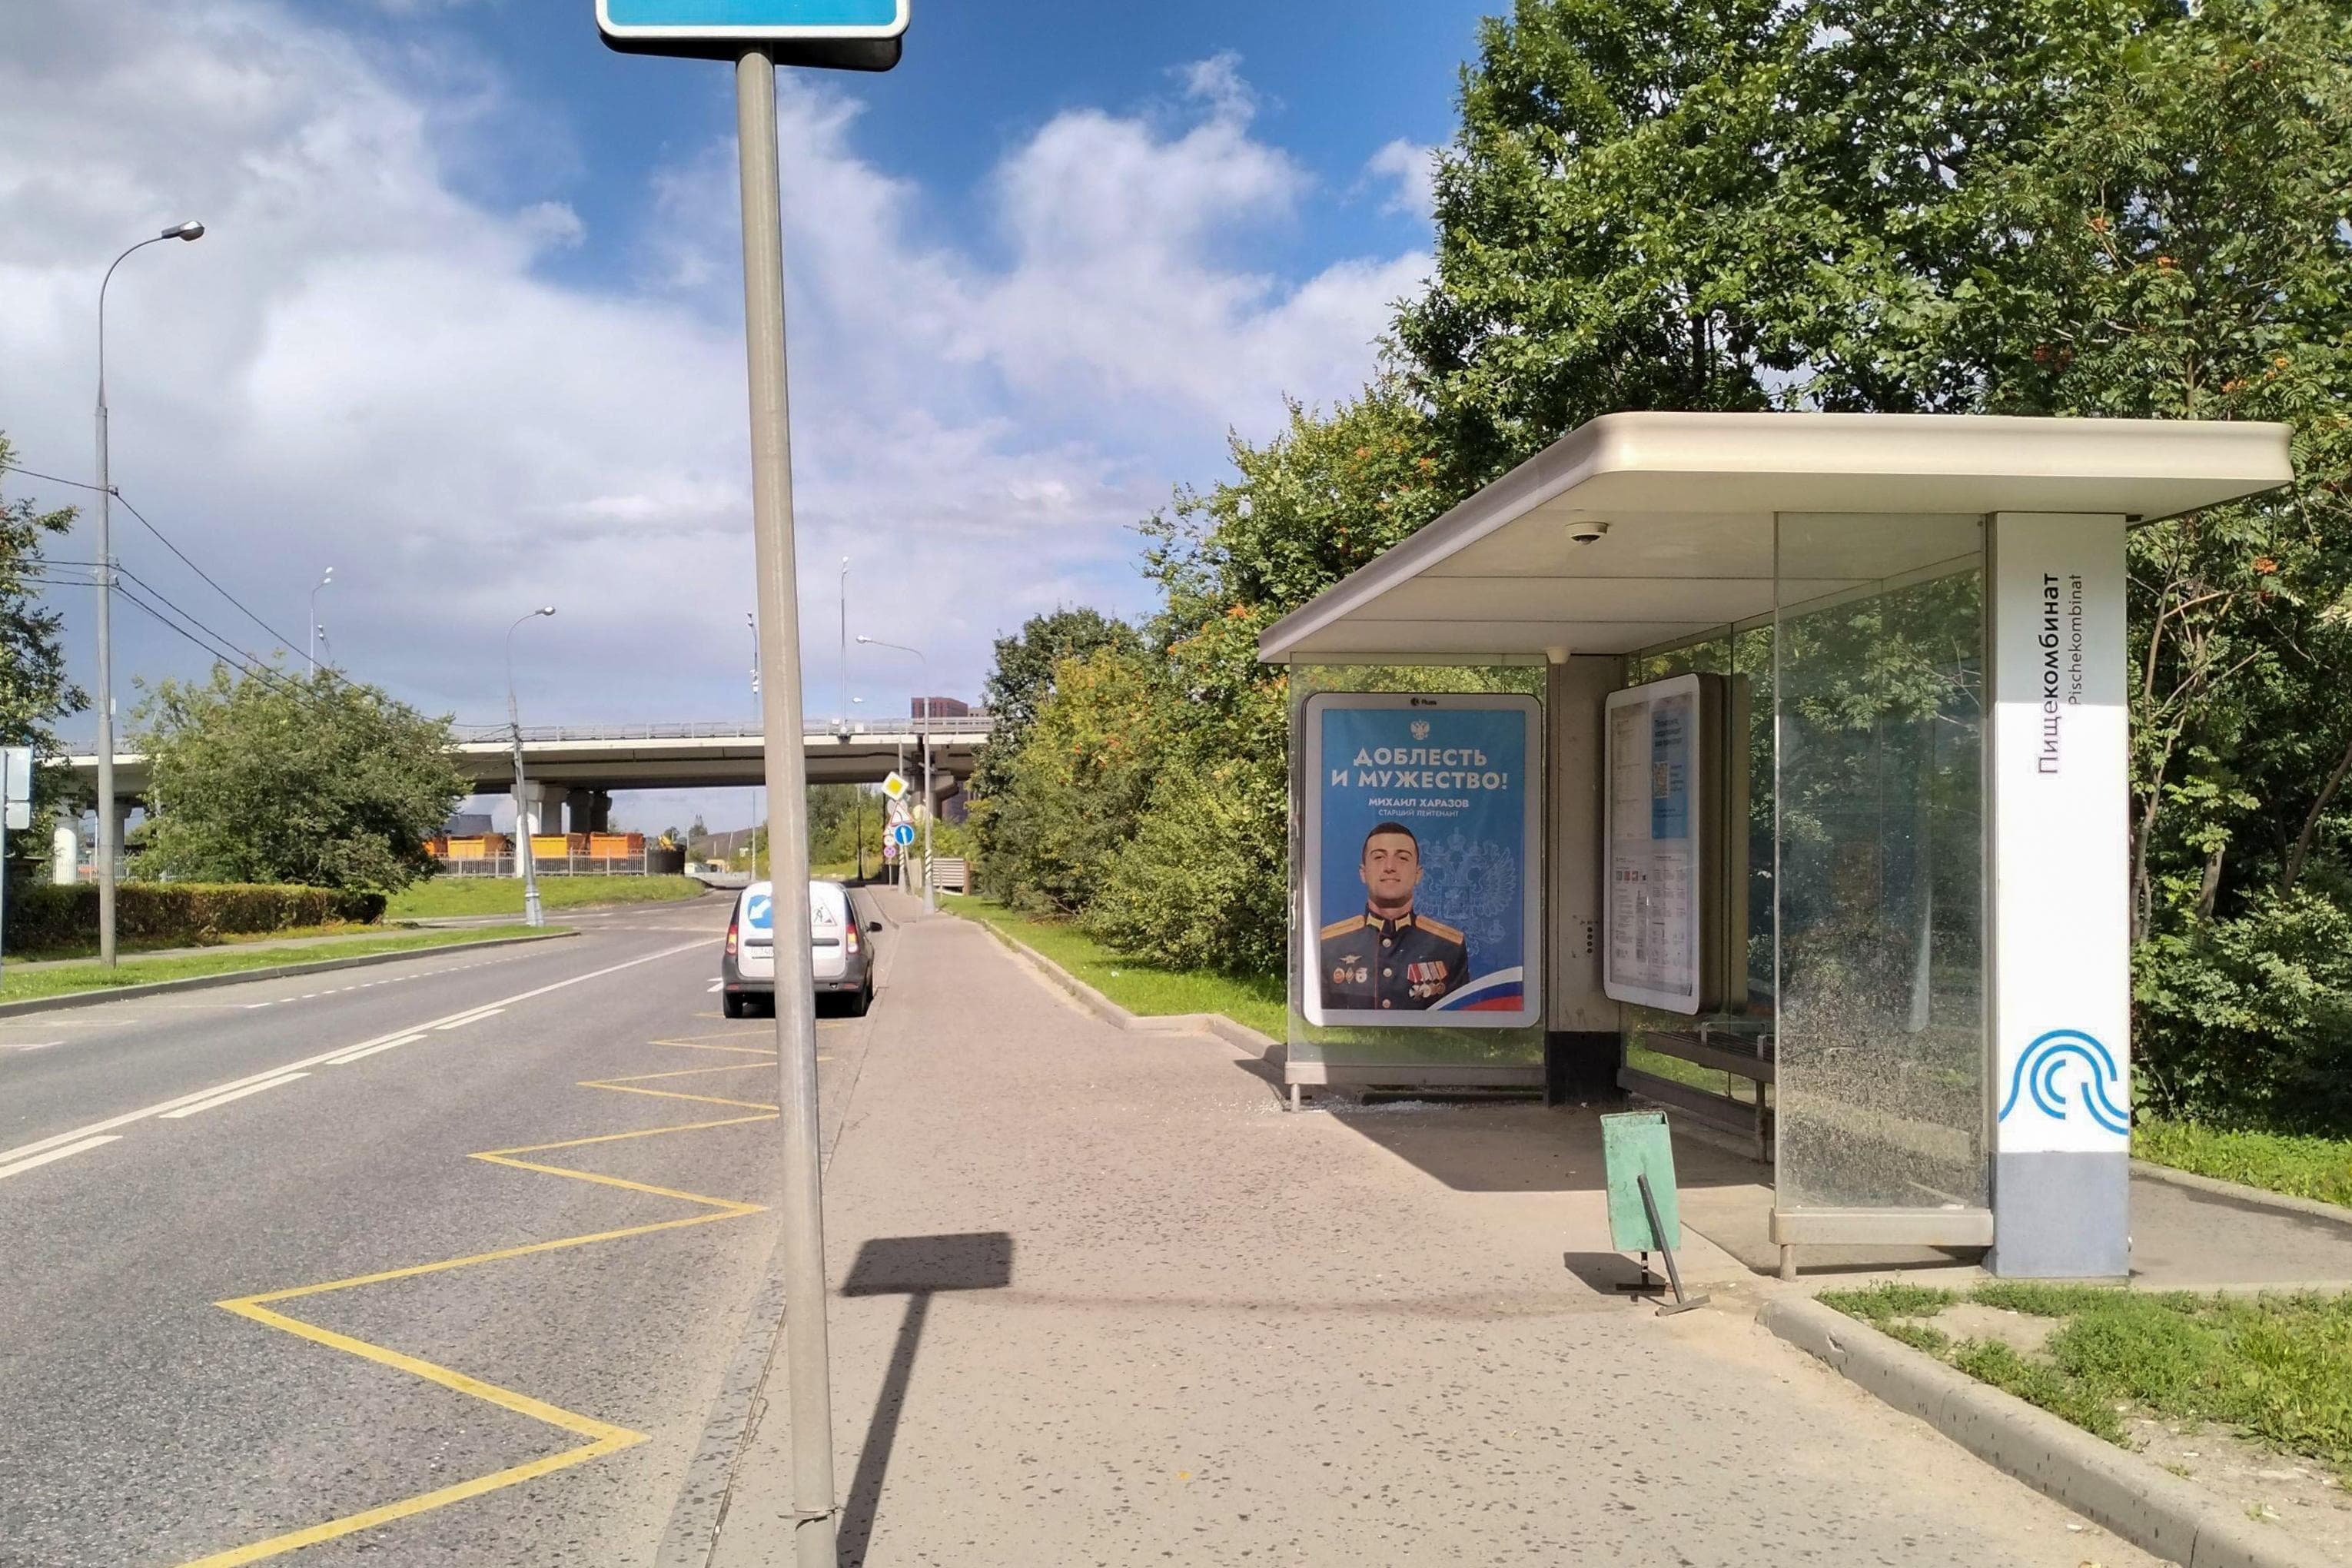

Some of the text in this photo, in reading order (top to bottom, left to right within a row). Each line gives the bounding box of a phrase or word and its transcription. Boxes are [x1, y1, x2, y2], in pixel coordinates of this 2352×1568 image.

[2068, 573, 2082, 706] Pischekombinat
[2038, 573, 2062, 774] Пищекомбинат
[1353, 747, 1488, 767] ДОБЛЕСТЬ
[1331, 769, 1509, 790] И МУЖЕСТВО!
[1368, 798, 1470, 808] МИХАИЛ ХАРАЗОВ
[1378, 809, 1460, 817] СТАРШИЙ ЛЕЙТЕНАНТ
